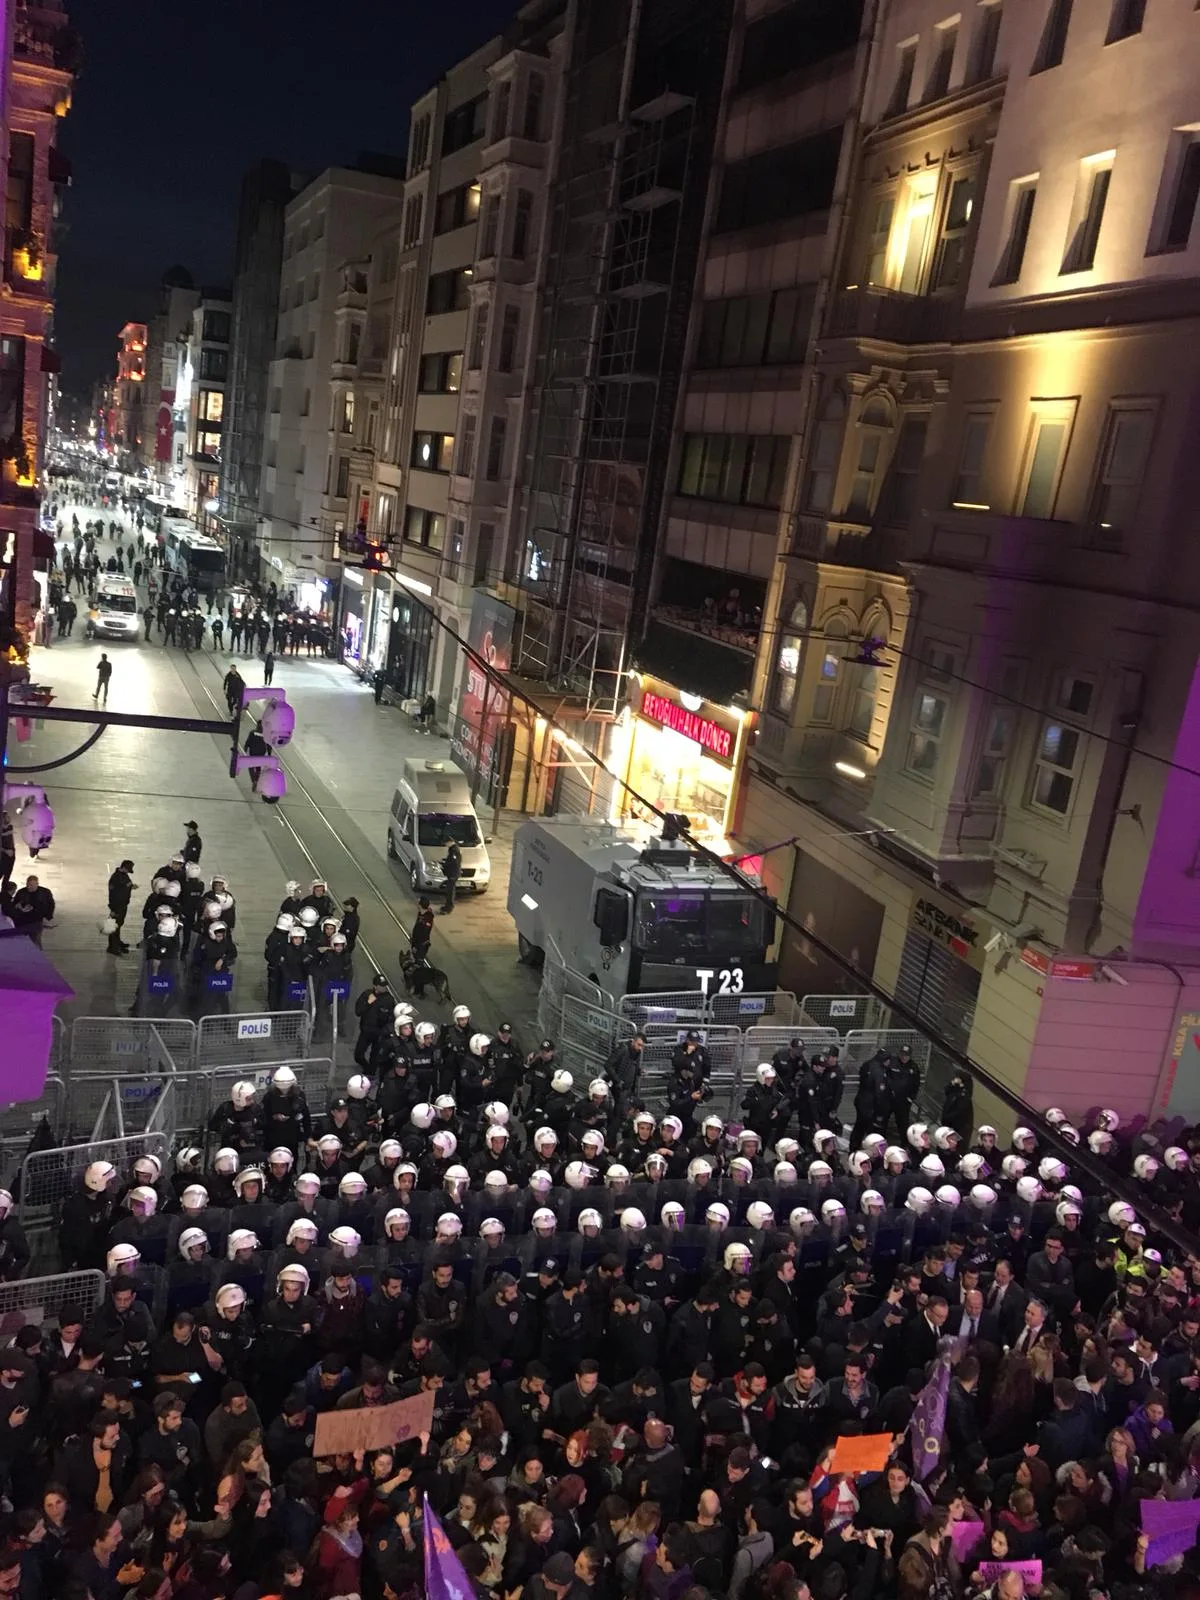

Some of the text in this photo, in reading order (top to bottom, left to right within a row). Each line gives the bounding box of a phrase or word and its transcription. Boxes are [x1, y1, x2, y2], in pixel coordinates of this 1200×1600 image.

[122, 586, 135, 596] 112
[643, 692, 731, 757] BEYOĞLU HALK DÖNER
[527, 859, 544, 887] T-23
[696, 967, 745, 995] T 23
[740, 1002, 764, 1011] POLİS
[832, 1002, 854, 1012] POLİS
[241, 1022, 269, 1035] POLİS
